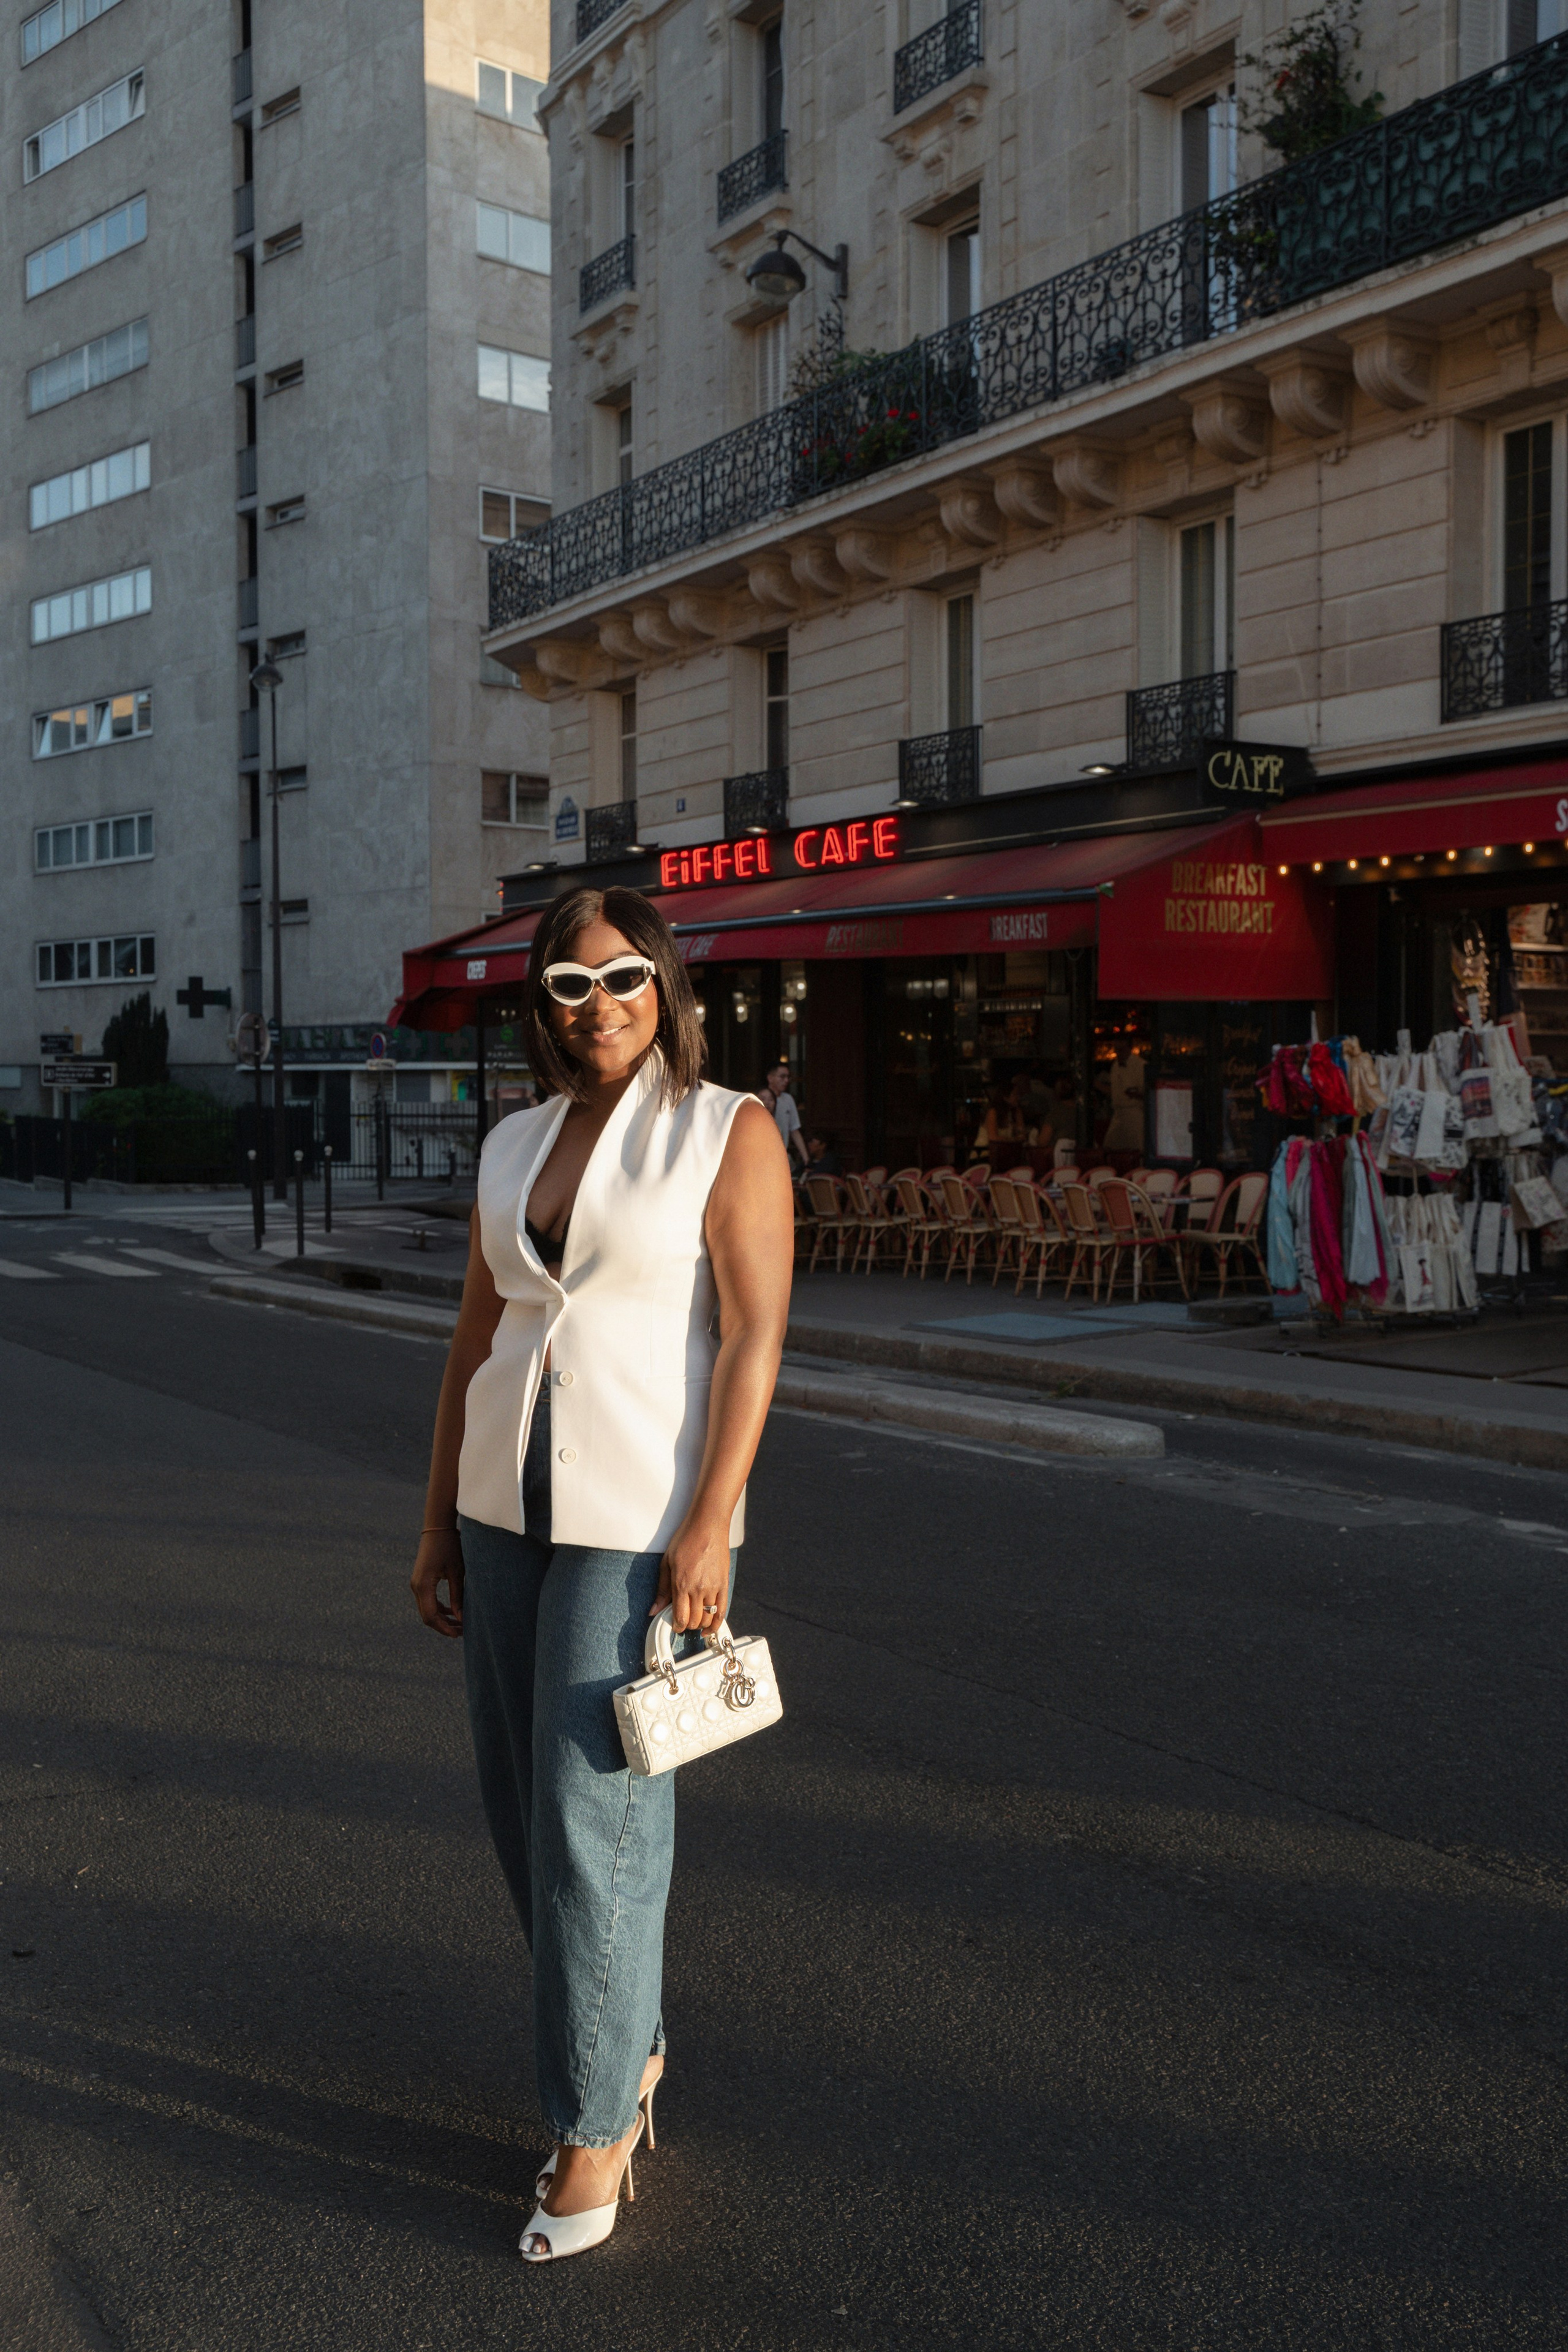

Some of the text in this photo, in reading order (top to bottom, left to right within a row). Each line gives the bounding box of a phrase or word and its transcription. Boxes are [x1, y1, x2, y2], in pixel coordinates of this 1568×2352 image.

[794, 818, 897, 868] CAFE
[1171, 861, 1268, 896] BREAKFAST
[989, 912, 1048, 941] BREAKFAST
[1164, 898, 1276, 934] RESTAURANT
[825, 919, 904, 953] RESTAURANT
